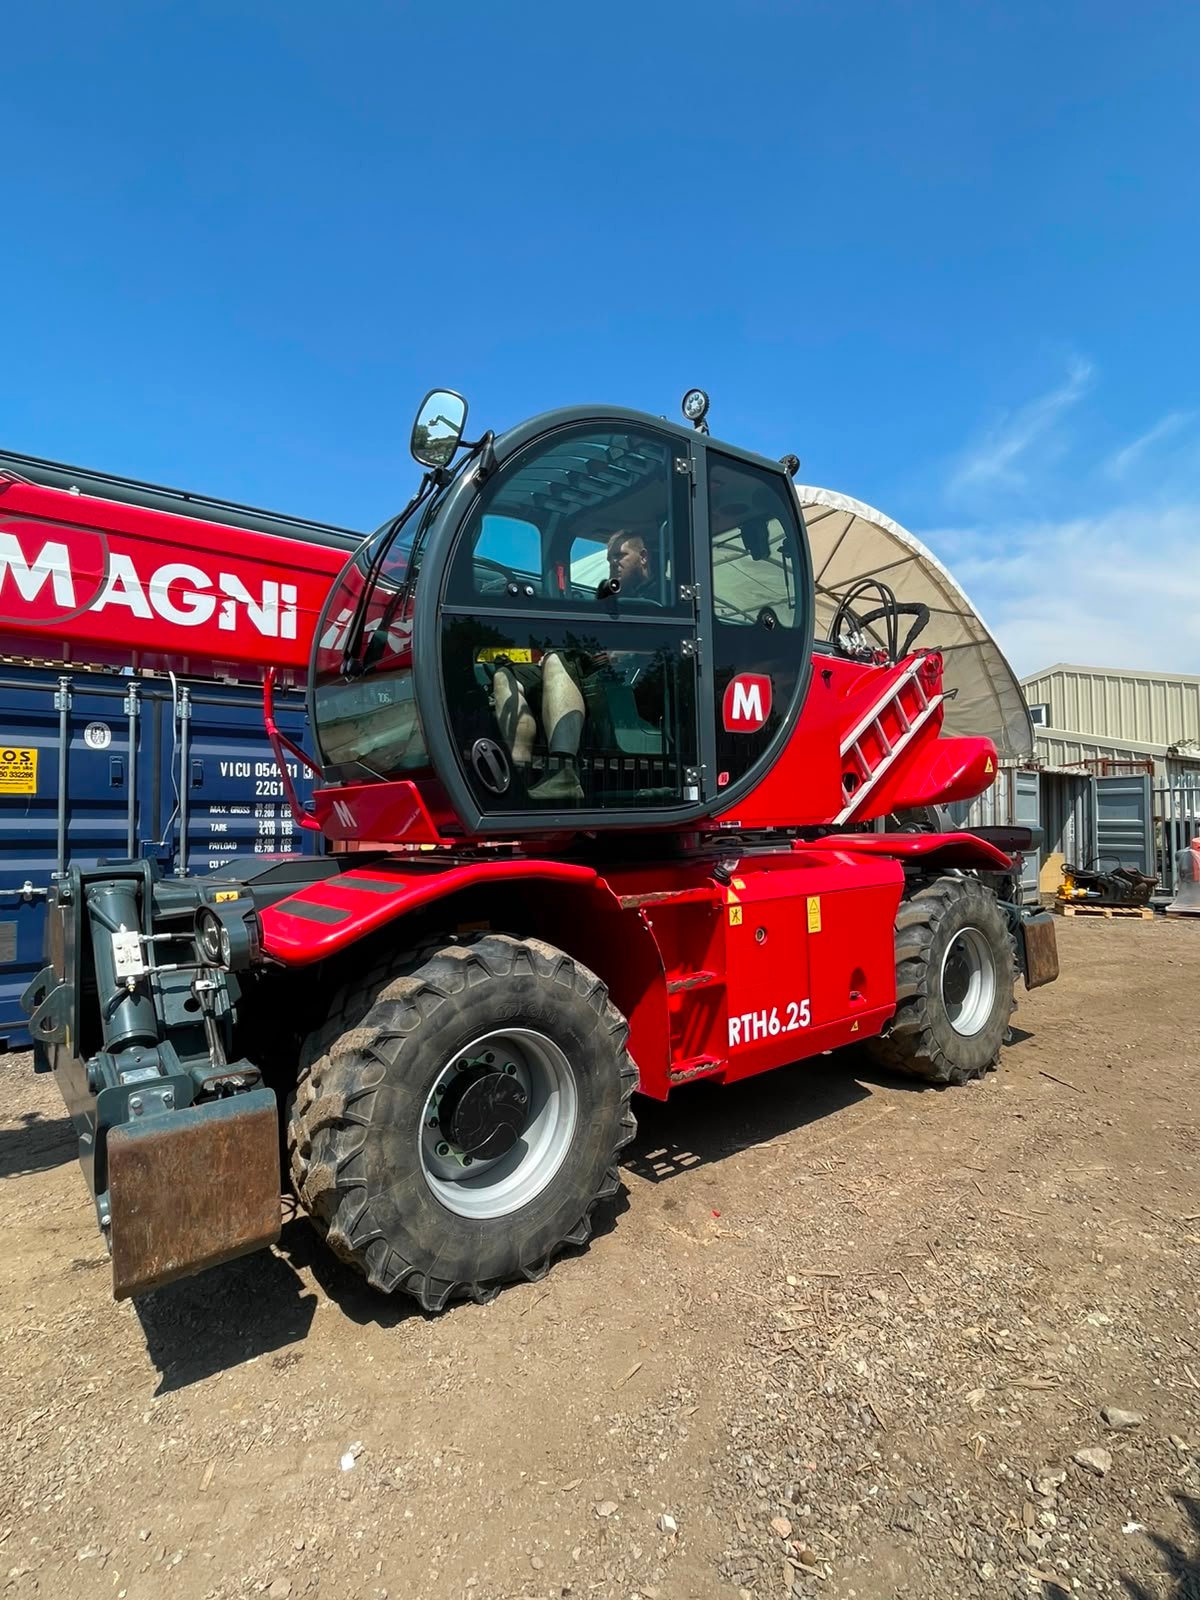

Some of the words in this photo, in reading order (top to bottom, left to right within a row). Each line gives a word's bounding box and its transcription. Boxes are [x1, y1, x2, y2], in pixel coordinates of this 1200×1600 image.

[0, 532, 297, 639] MAGNI
[732, 682, 763, 721] M
[220, 762, 250, 777] VICU
[255, 781, 284, 796] 22G1
[209, 805, 229, 814] MAX.
[230, 806, 251, 814] GROSS
[280, 809, 292, 818] LBS
[210, 823, 228, 832] TARE
[208, 842, 237, 850] PAYLOAD
[280, 845, 292, 853] LBS
[209, 860, 219, 869] CU
[728, 999, 811, 1047] RTH6.25
